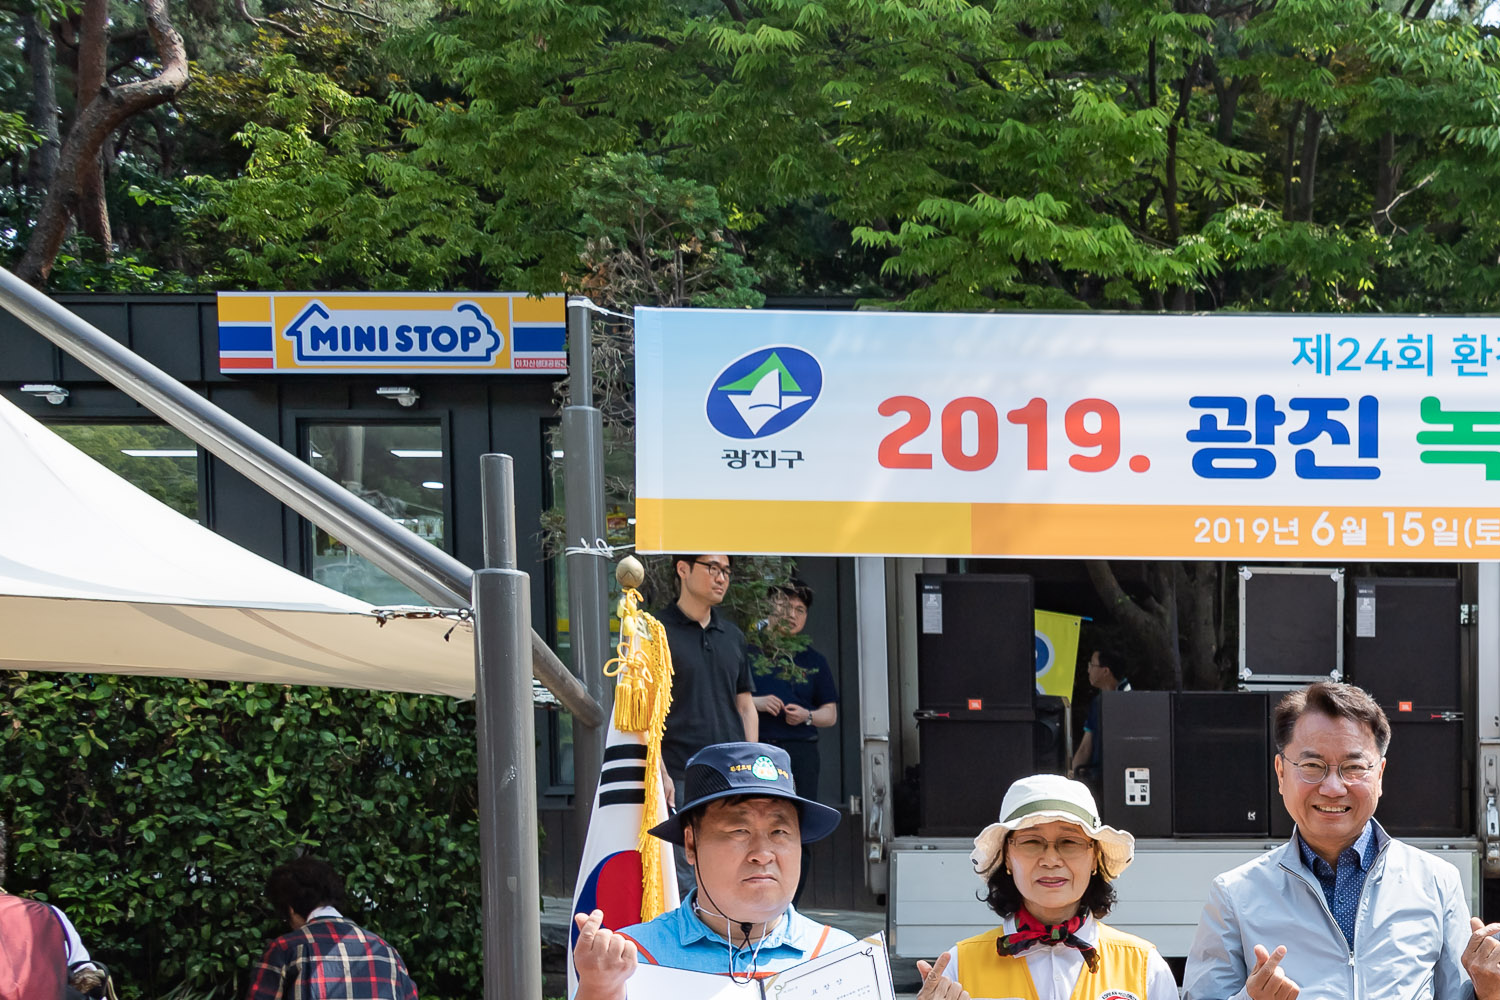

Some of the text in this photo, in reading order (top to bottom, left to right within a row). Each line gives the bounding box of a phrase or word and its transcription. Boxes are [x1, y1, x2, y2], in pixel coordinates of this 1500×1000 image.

[1291, 333, 1434, 377] 제24회
[877, 395, 1151, 473] 2019.
[1185, 394, 1381, 480] 광진
[721, 449, 805, 470] 광진구
[1194, 517, 1299, 546] 2019년
[1311, 511, 1367, 547] 6월
